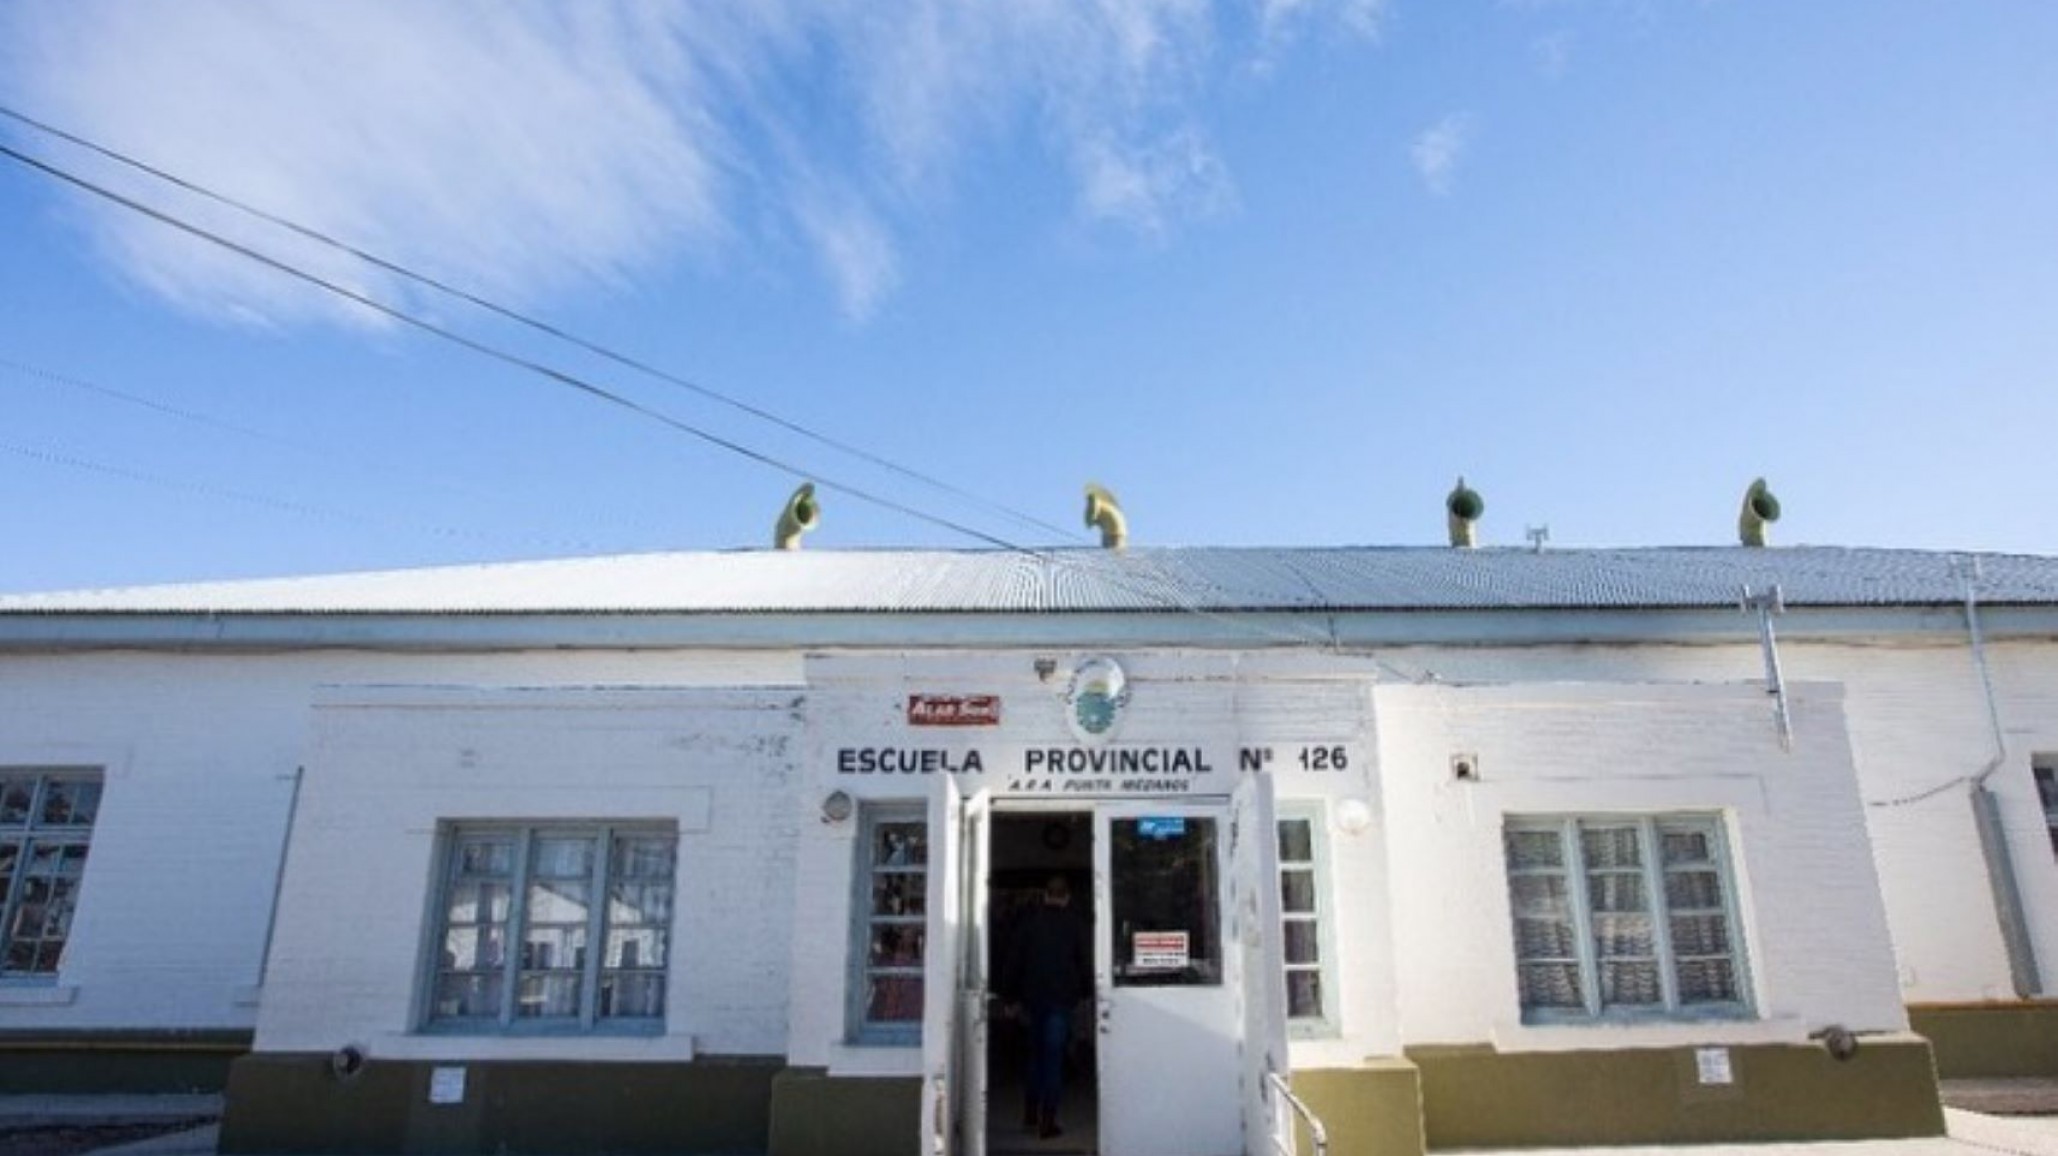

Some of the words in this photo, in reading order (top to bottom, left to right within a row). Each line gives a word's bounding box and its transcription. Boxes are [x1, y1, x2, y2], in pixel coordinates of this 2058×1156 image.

[838, 748, 983, 773] ESCUELA
[1025, 748, 1213, 773] PROVINCIAL
[1298, 745, 1347, 771] 126
